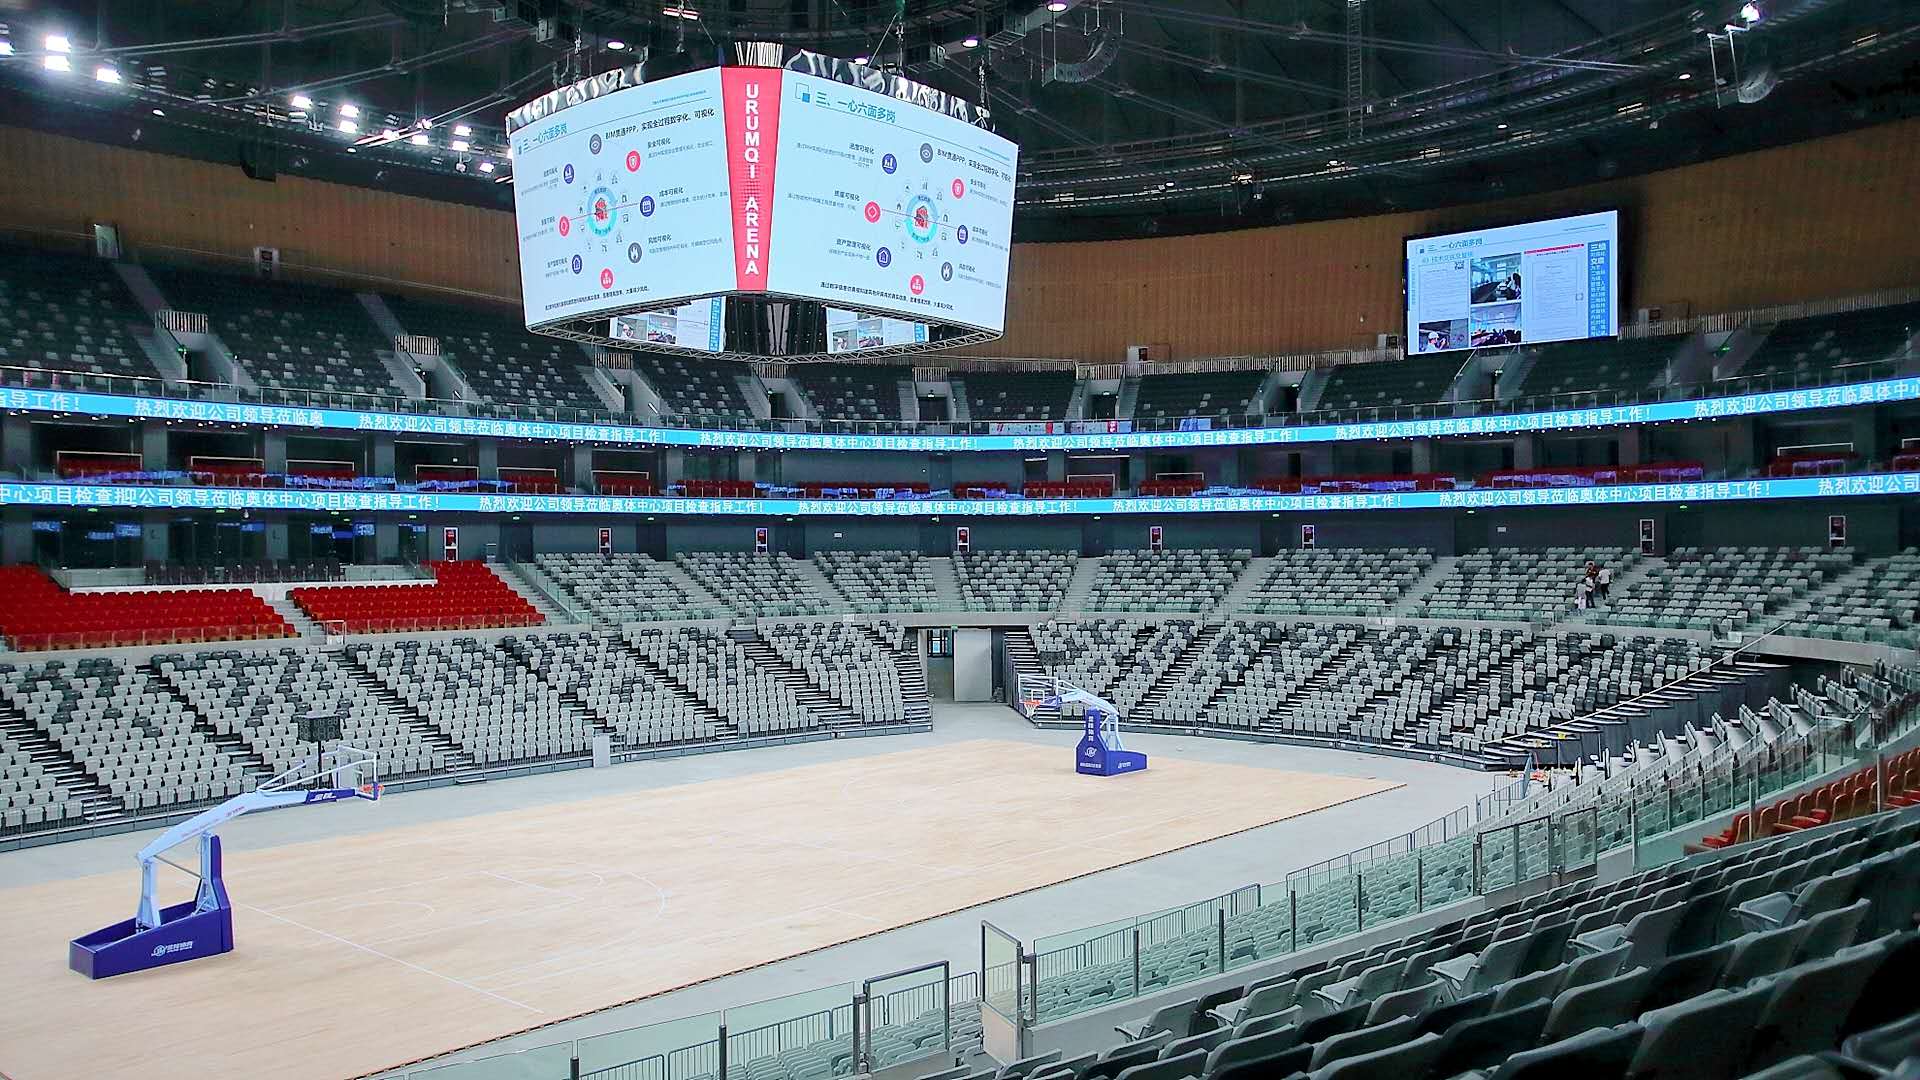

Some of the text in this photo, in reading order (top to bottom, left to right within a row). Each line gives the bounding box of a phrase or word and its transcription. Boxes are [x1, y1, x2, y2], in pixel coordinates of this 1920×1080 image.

[744, 83, 760, 275] URUMQI ARENA
[135, 398, 324, 427] 热烈欢迎公司领导莅临奥
[359, 414, 667, 443] 热烈欢迎公司领导莅临奥体中心项目检查指导工作！
[1335, 407, 1651, 440] 热烈欢迎公司领导莅临奥体中心项目检查指导工作！
[699, 433, 978, 449] 热烈欢迎公司领导莅临奥体中心项目检查指导工作！
[1013, 430, 1299, 449] 热烈欢迎公司领导莅临奥体中心项目检查指导工作！
[1440, 483, 1771, 506] 热烈欢迎公司领导莅临奥体中心项目检查指导工作！
[1818, 474, 1919, 495] 热烈欢迎公司
[479, 495, 763, 514] 热烈欢迎公司领导莅临奥体中心项目检查指导工作！
[798, 500, 1077, 514] 热烈欢迎公司领导莅临奥体中心项目检查指导工作！
[1113, 495, 1401, 512] 热烈欢迎公司领导莅临奥体中心项目检查指导工作！
